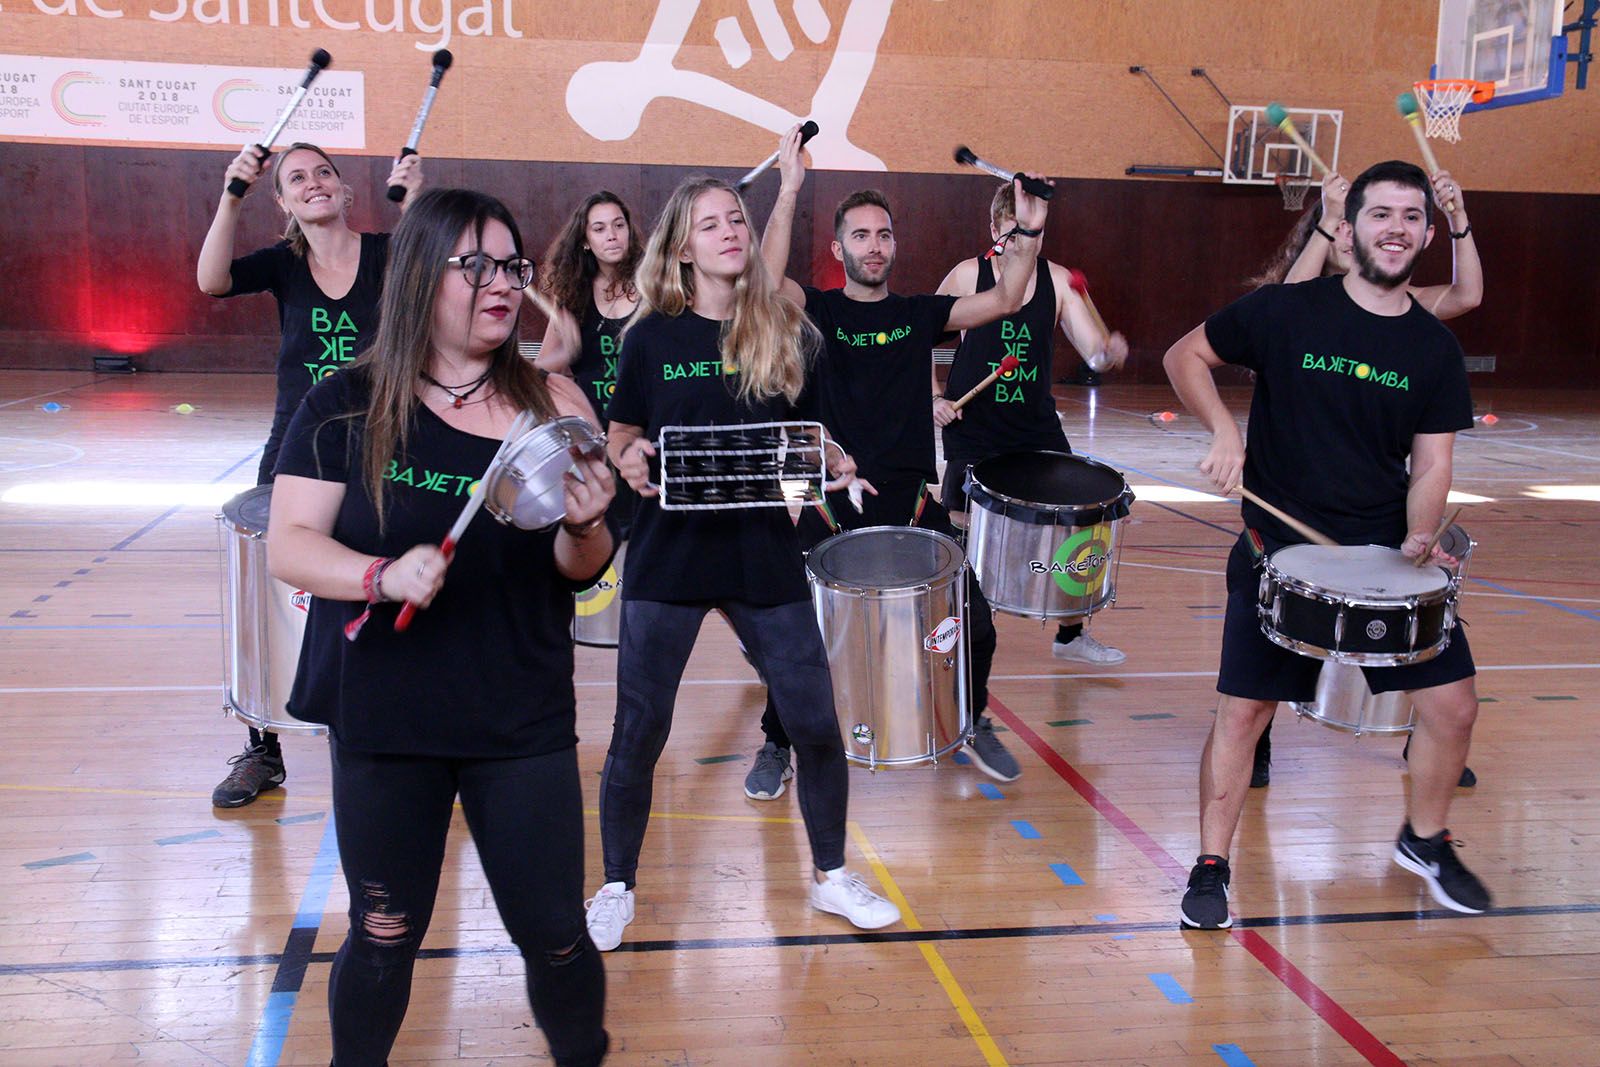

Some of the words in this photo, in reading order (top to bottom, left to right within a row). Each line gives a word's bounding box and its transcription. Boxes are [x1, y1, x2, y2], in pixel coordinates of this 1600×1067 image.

[0, 73, 36, 83] UGAT
[119, 79, 151, 88] SANT
[156, 80, 197, 91] CUGAT
[138, 91, 179, 101] 2018
[314, 88, 352, 97] CUGAT
[118, 102, 152, 112] CIUTAT
[153, 103, 200, 114] EUROPEA
[297, 98, 335, 108] 018
[129, 113, 143, 124] DE
[311, 109, 355, 120] EUROPEA
[312, 307, 359, 333] BA
[1001, 320, 1032, 340] BA
[318, 335, 356, 361] KE
[1302, 353, 1409, 391] BAKETOMBA
[995, 383, 1025, 403] BA
